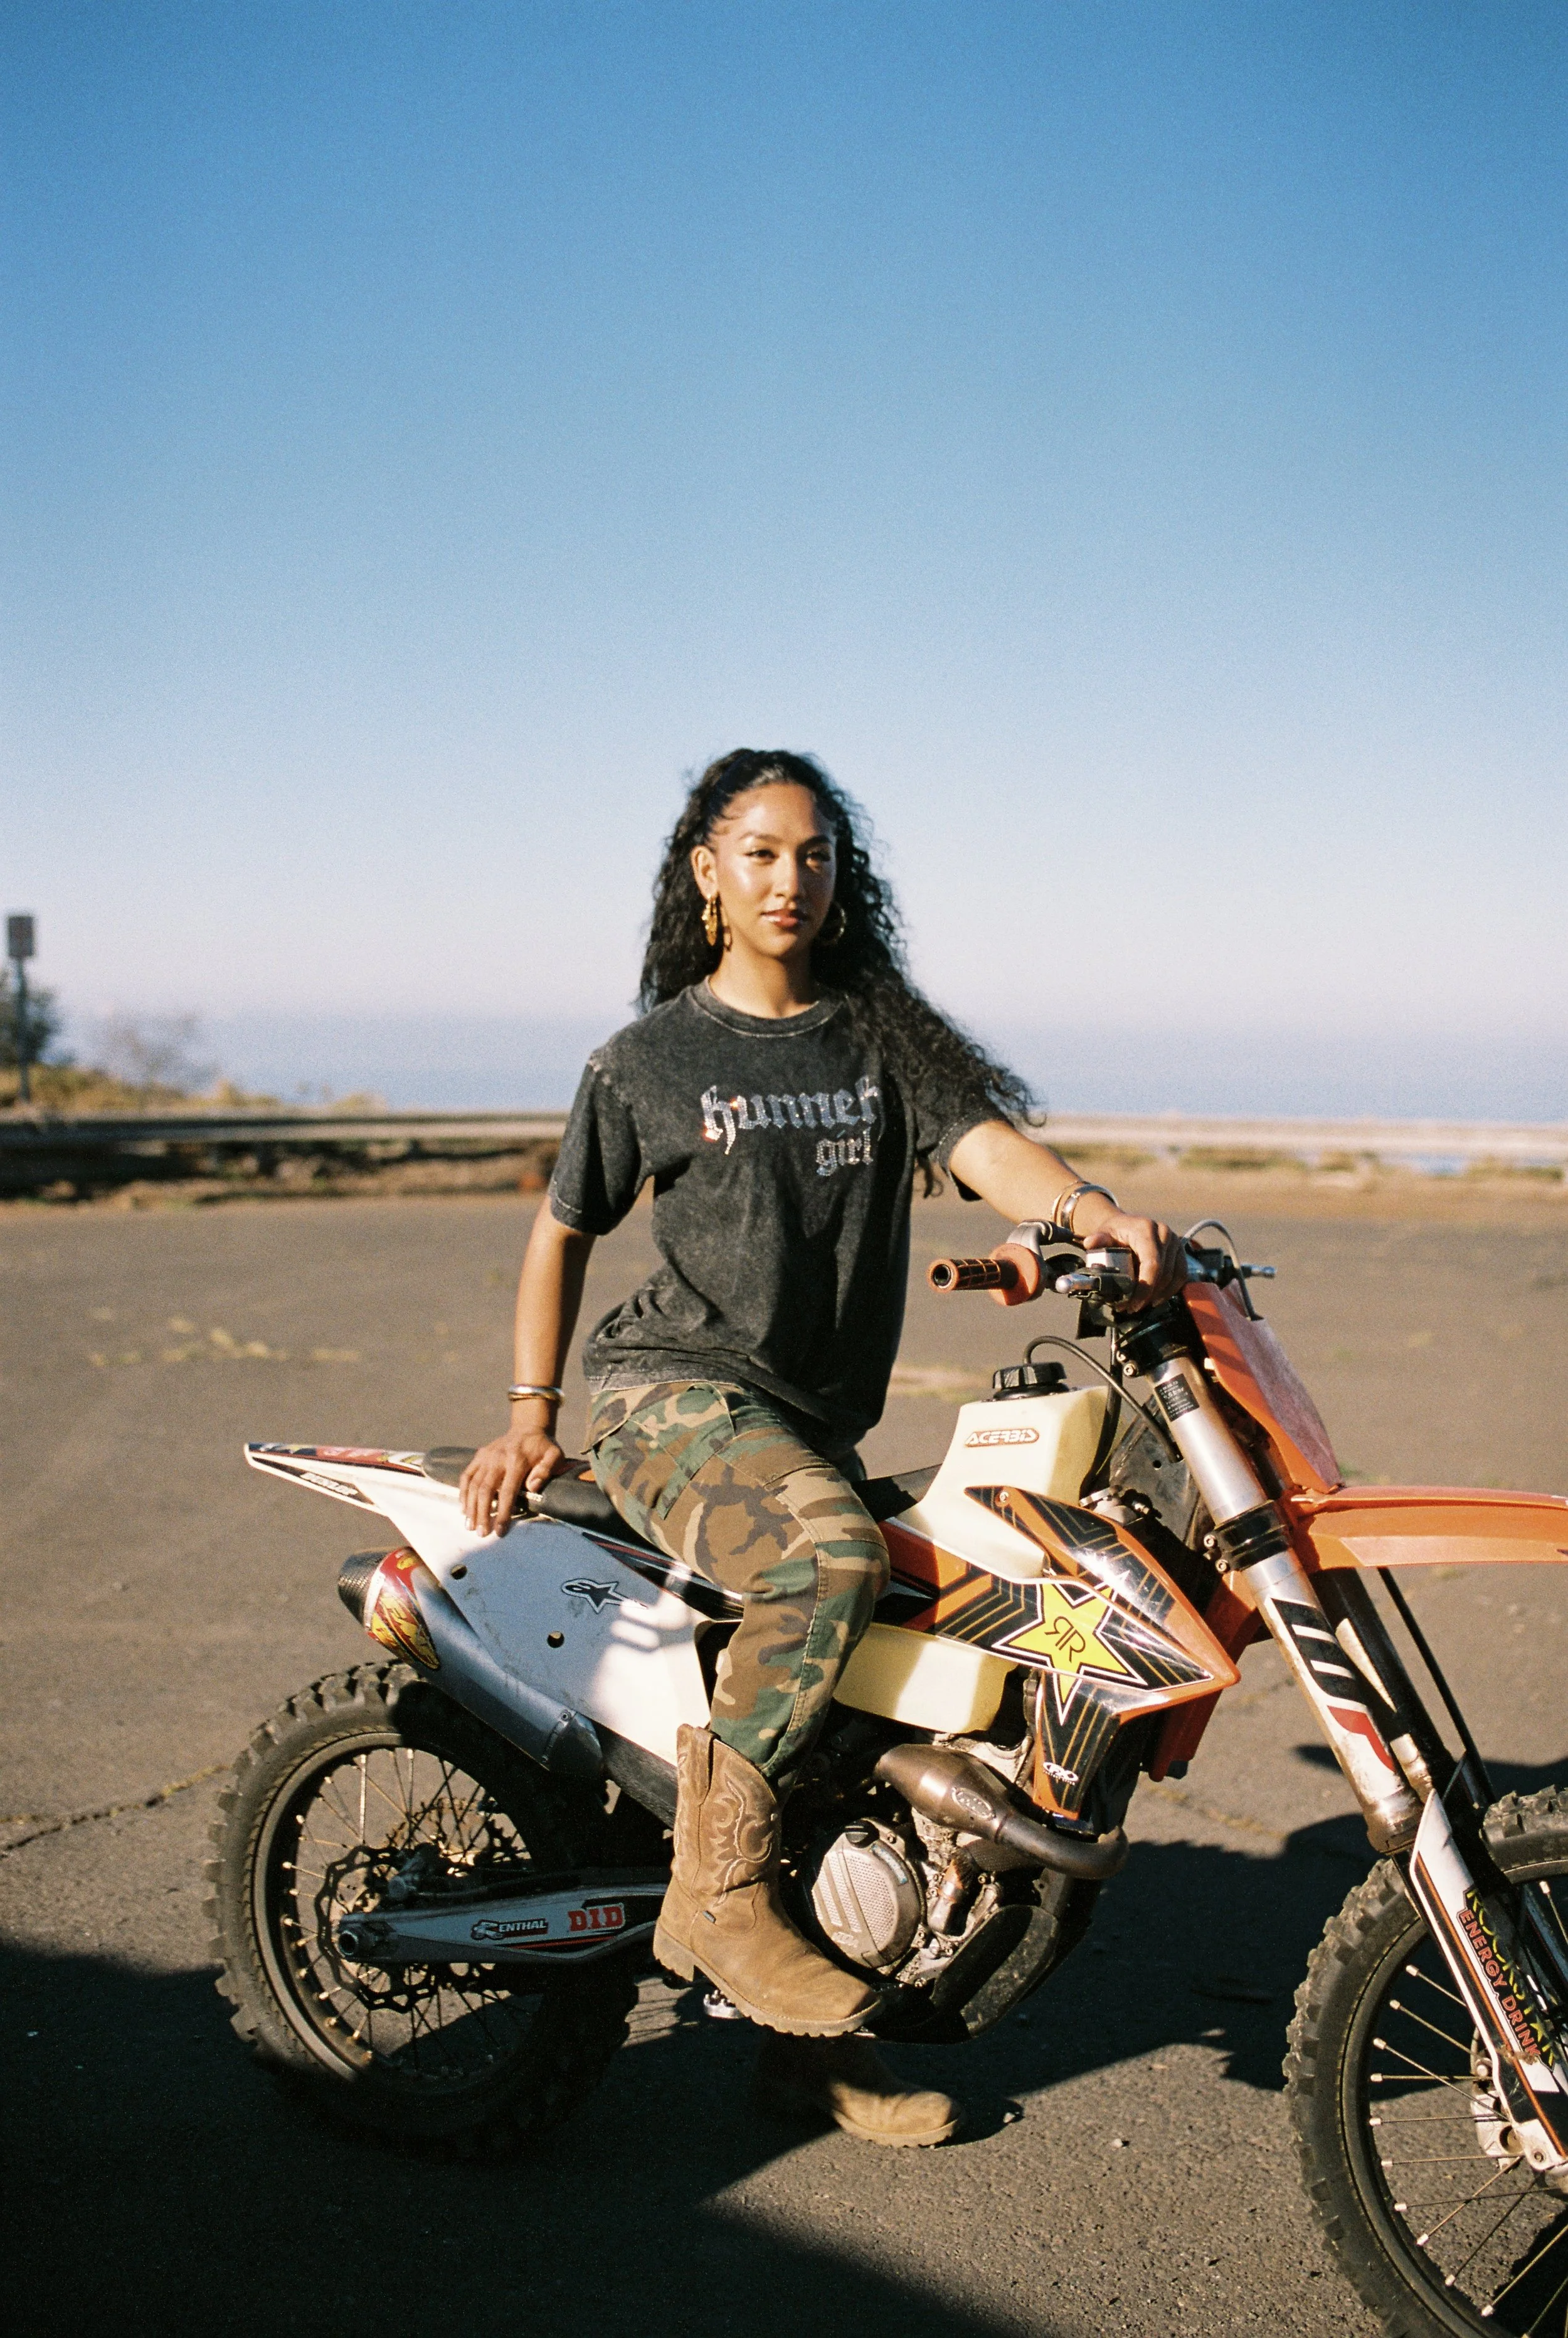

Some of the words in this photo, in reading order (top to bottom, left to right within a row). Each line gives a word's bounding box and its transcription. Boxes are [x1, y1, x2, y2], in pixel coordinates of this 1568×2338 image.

[816, 1127, 874, 1177] girl
[965, 1429, 1037, 1446] ACERBIS
[472, 1920, 547, 1940] RENTHAL
[1459, 1909, 1507, 1987] ENERGY
[1502, 1996, 1541, 2056] DRINK
